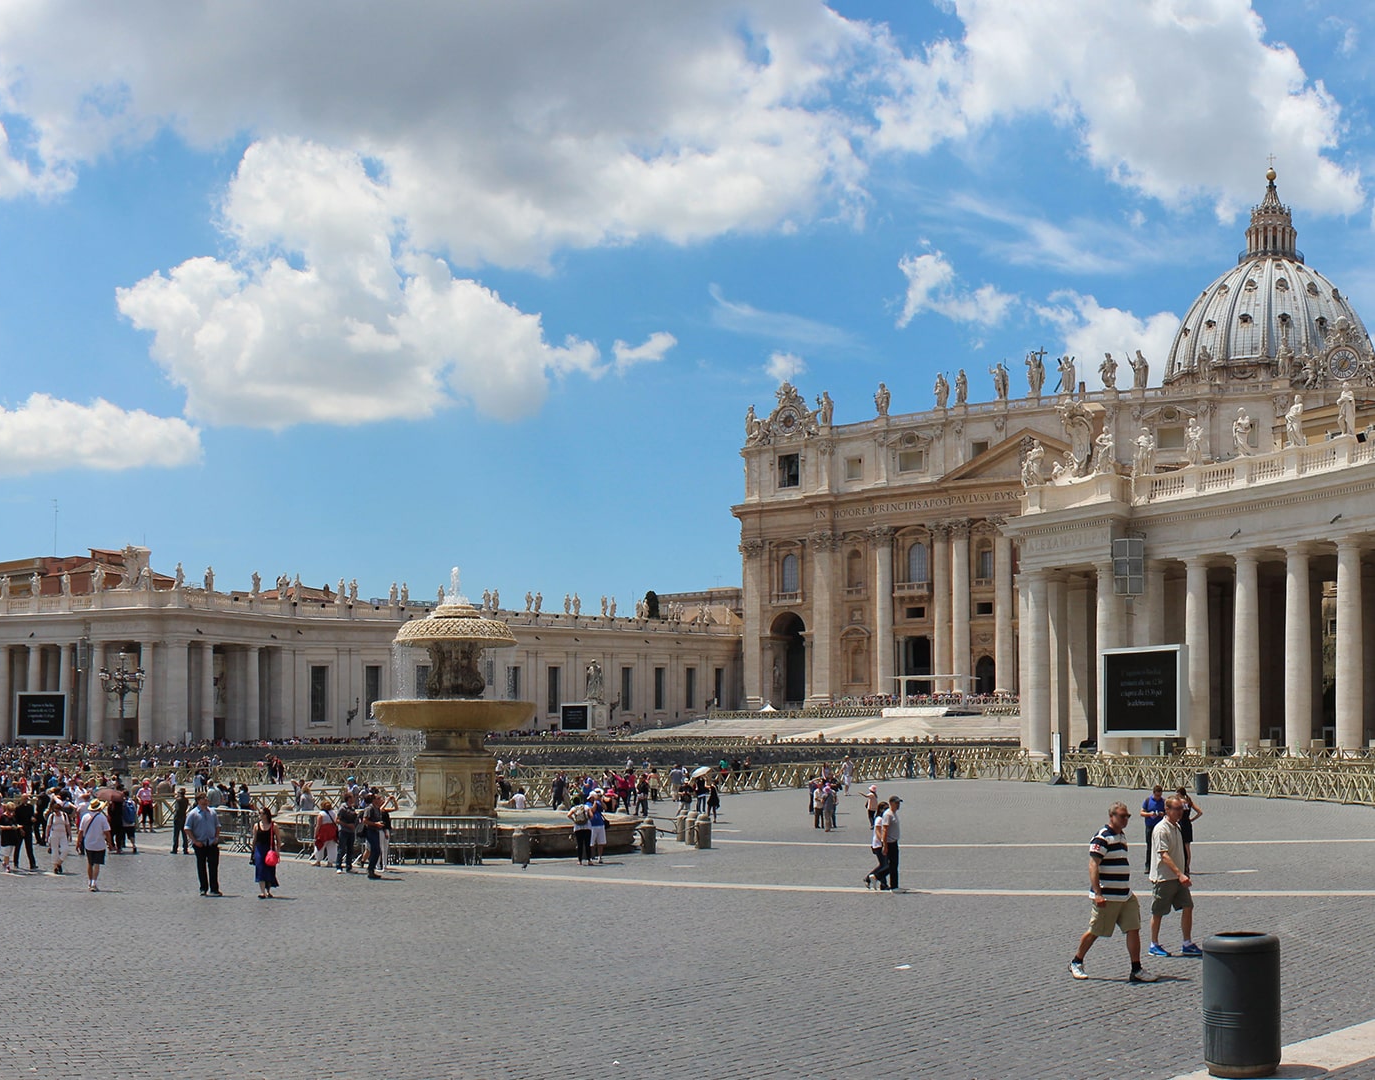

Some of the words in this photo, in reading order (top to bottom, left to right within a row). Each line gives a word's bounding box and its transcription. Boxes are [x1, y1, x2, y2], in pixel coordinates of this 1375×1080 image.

[815, 510, 826, 519] IN
[833, 506, 874, 519] HOOREM
[874, 500, 922, 513] PRINCIPIS
